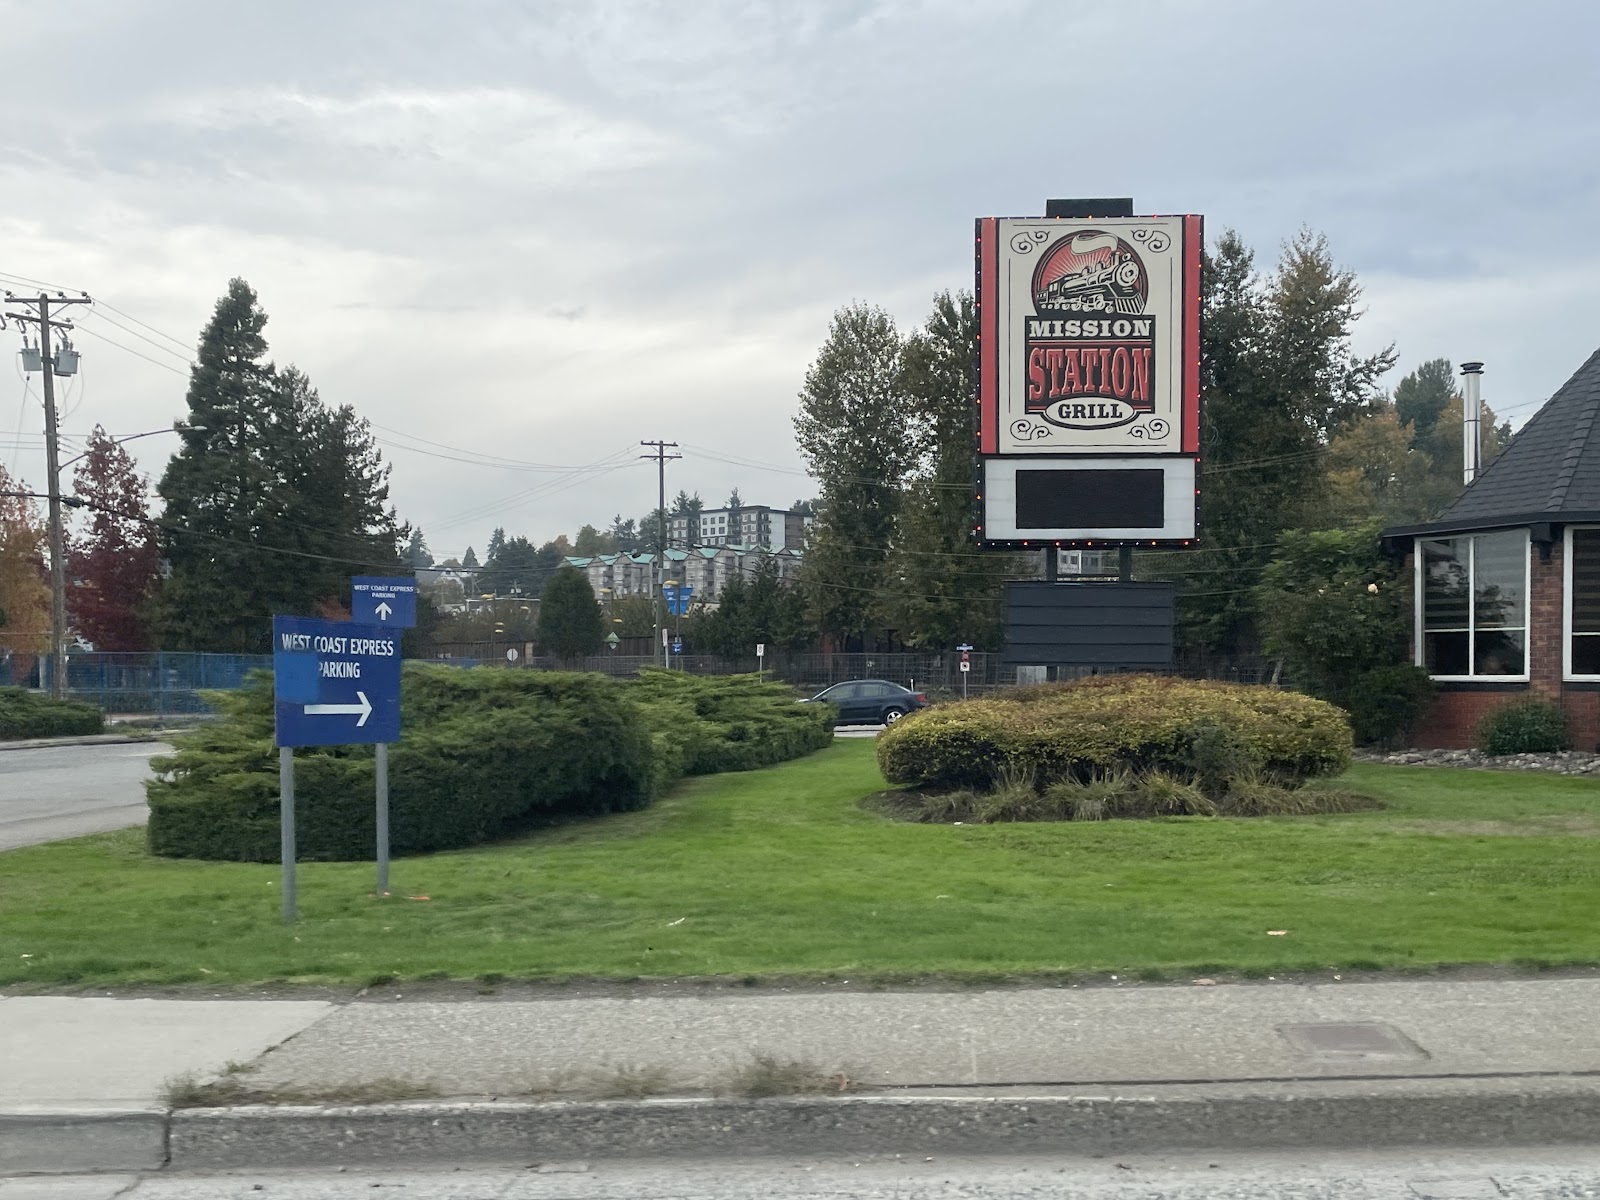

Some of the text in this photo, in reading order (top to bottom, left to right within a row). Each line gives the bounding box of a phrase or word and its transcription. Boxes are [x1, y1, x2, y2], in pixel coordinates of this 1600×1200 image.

[1029, 319, 1151, 337] MISSION
[1029, 347, 1151, 401] STATION
[1058, 404, 1122, 419] GRILL
[281, 633, 394, 656] WEST COAST EXPRESS
